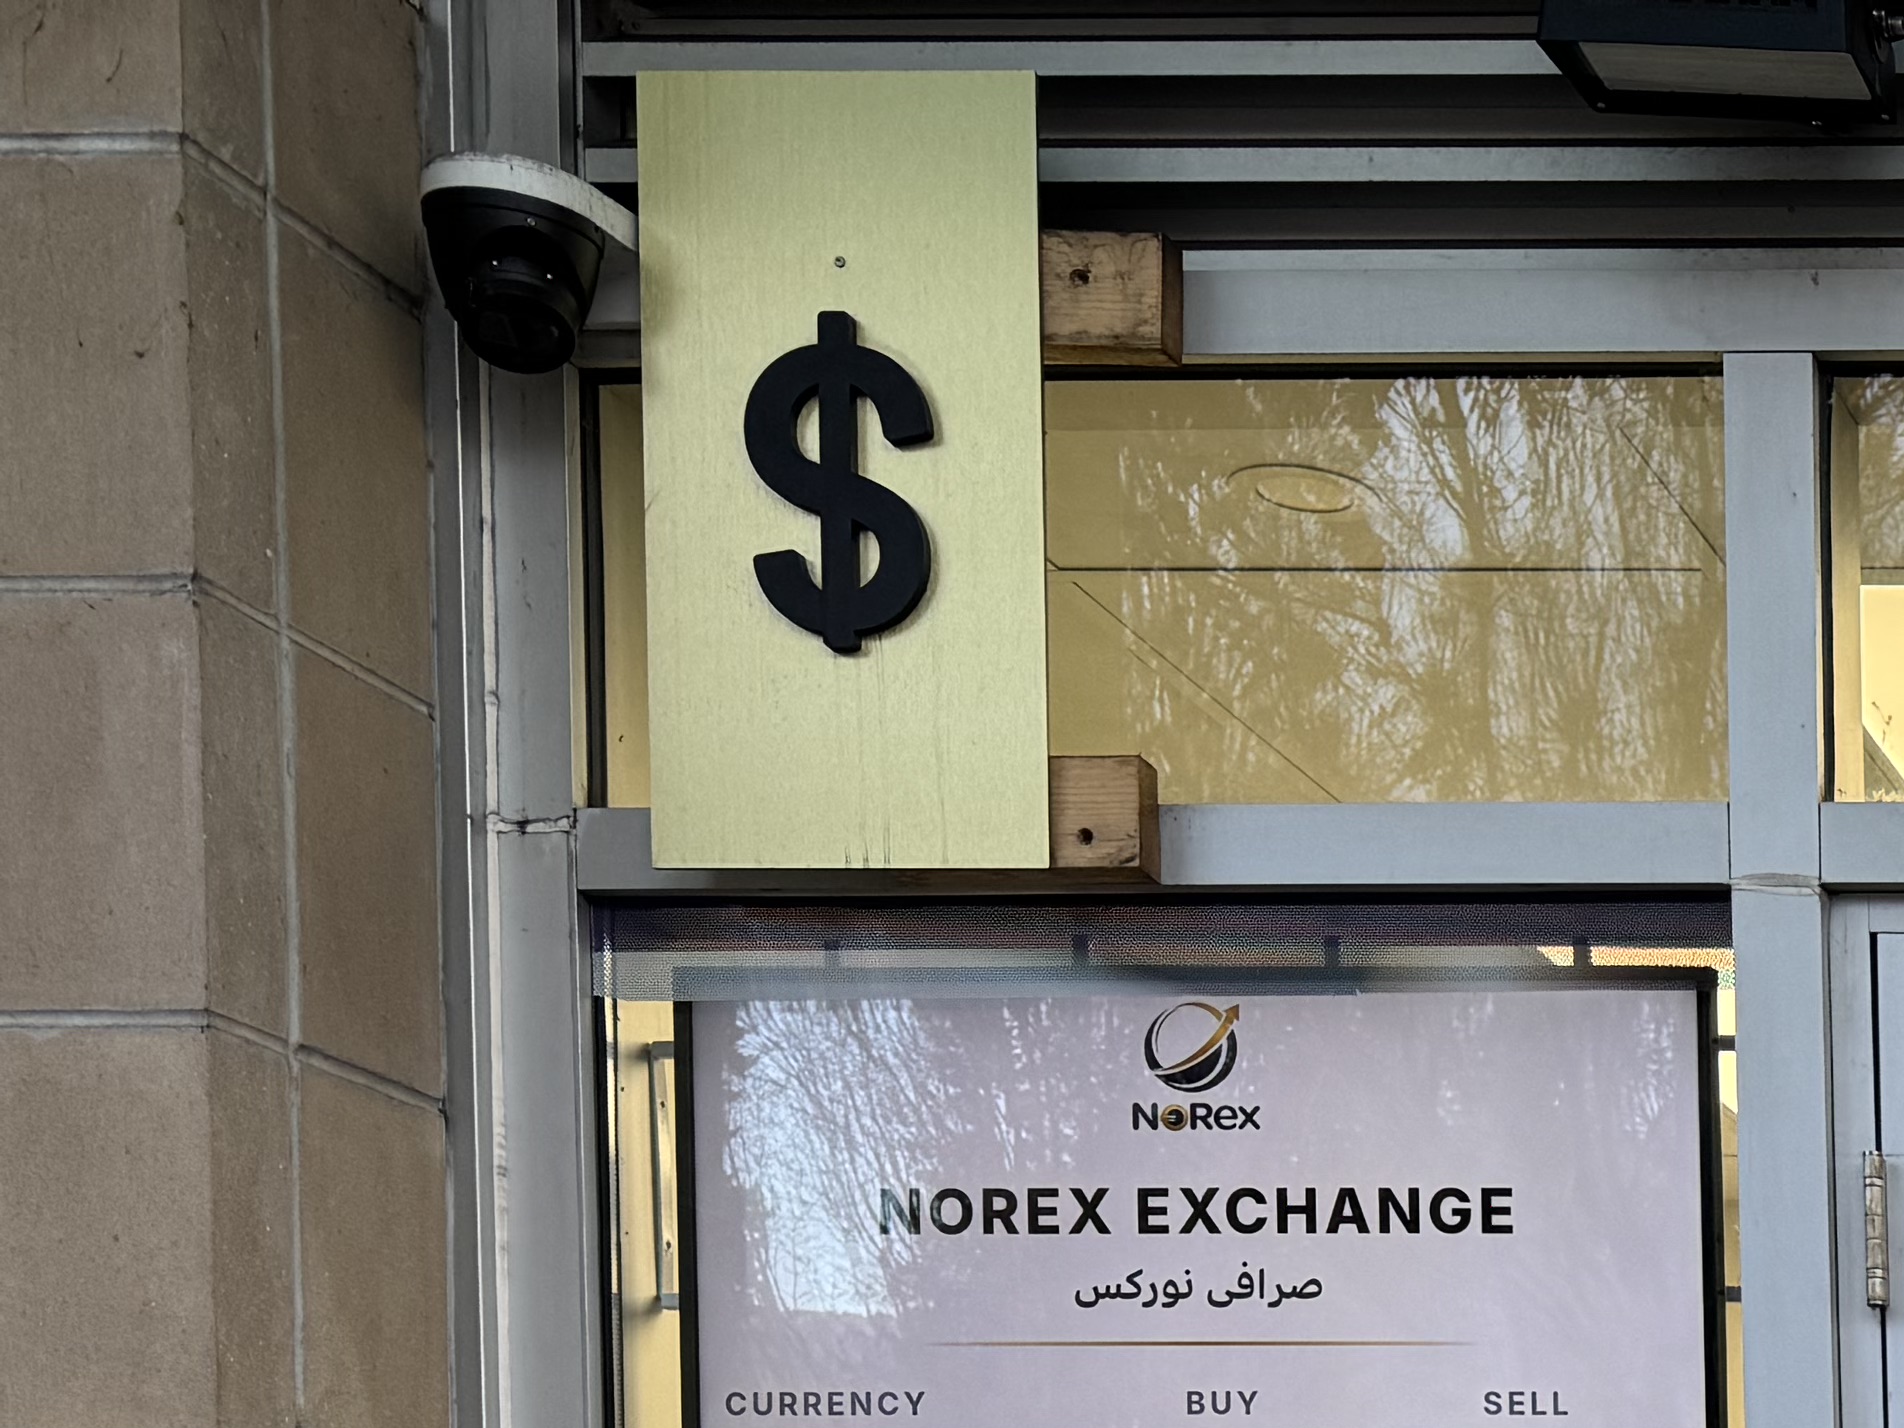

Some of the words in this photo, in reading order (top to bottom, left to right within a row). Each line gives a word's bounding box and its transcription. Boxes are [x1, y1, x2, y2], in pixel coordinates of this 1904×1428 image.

[880, 1188, 1111, 1235] NOREX
[1138, 1188, 1513, 1234] EXCHANGE
[1075, 1269, 1192, 1308] نورکس
[1207, 1261, 1322, 1308] صرافی
[726, 1391, 924, 1416] CURRENCY
[1187, 1391, 1257, 1415] BUY
[1484, 1391, 1568, 1415] SELL
